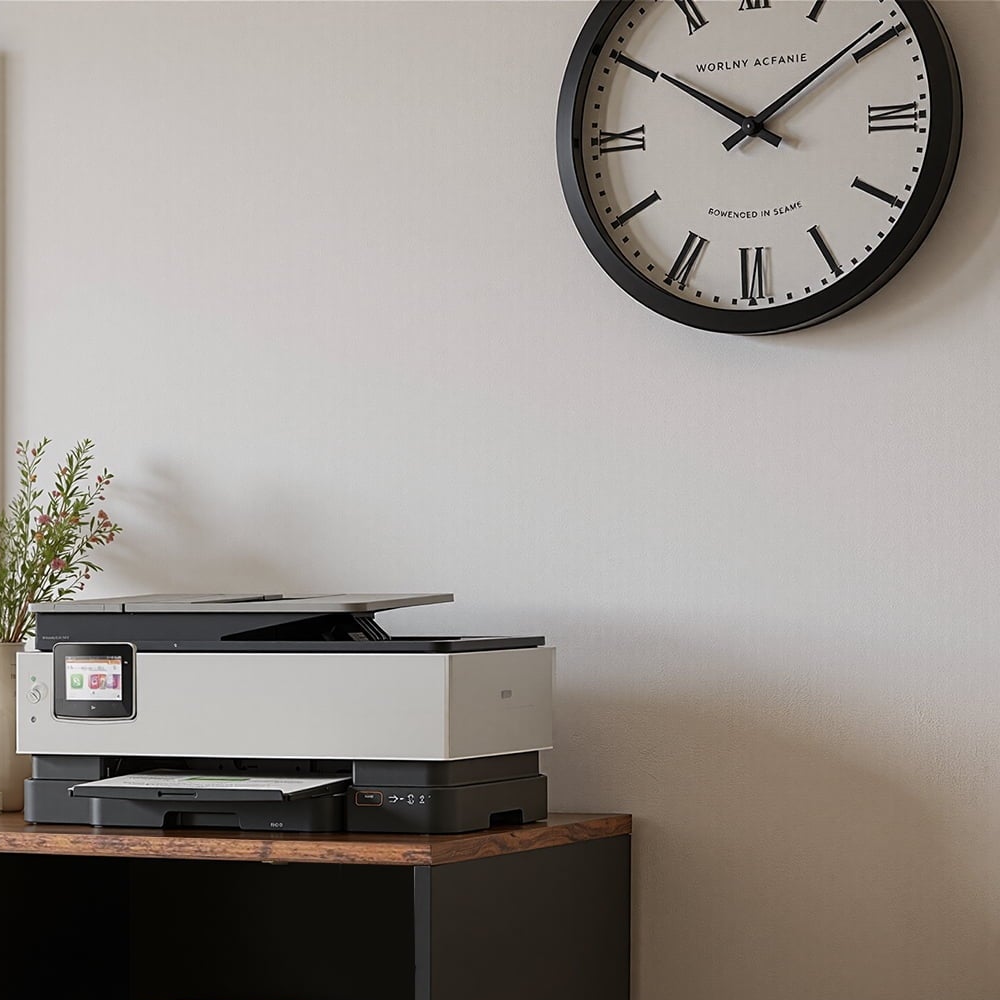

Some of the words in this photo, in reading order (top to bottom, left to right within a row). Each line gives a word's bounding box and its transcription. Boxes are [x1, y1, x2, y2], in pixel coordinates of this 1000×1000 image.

[696, 59, 749, 72] WORLNY
[753, 53, 808, 67] ACFANIE
[760, 209, 771, 217] IN
